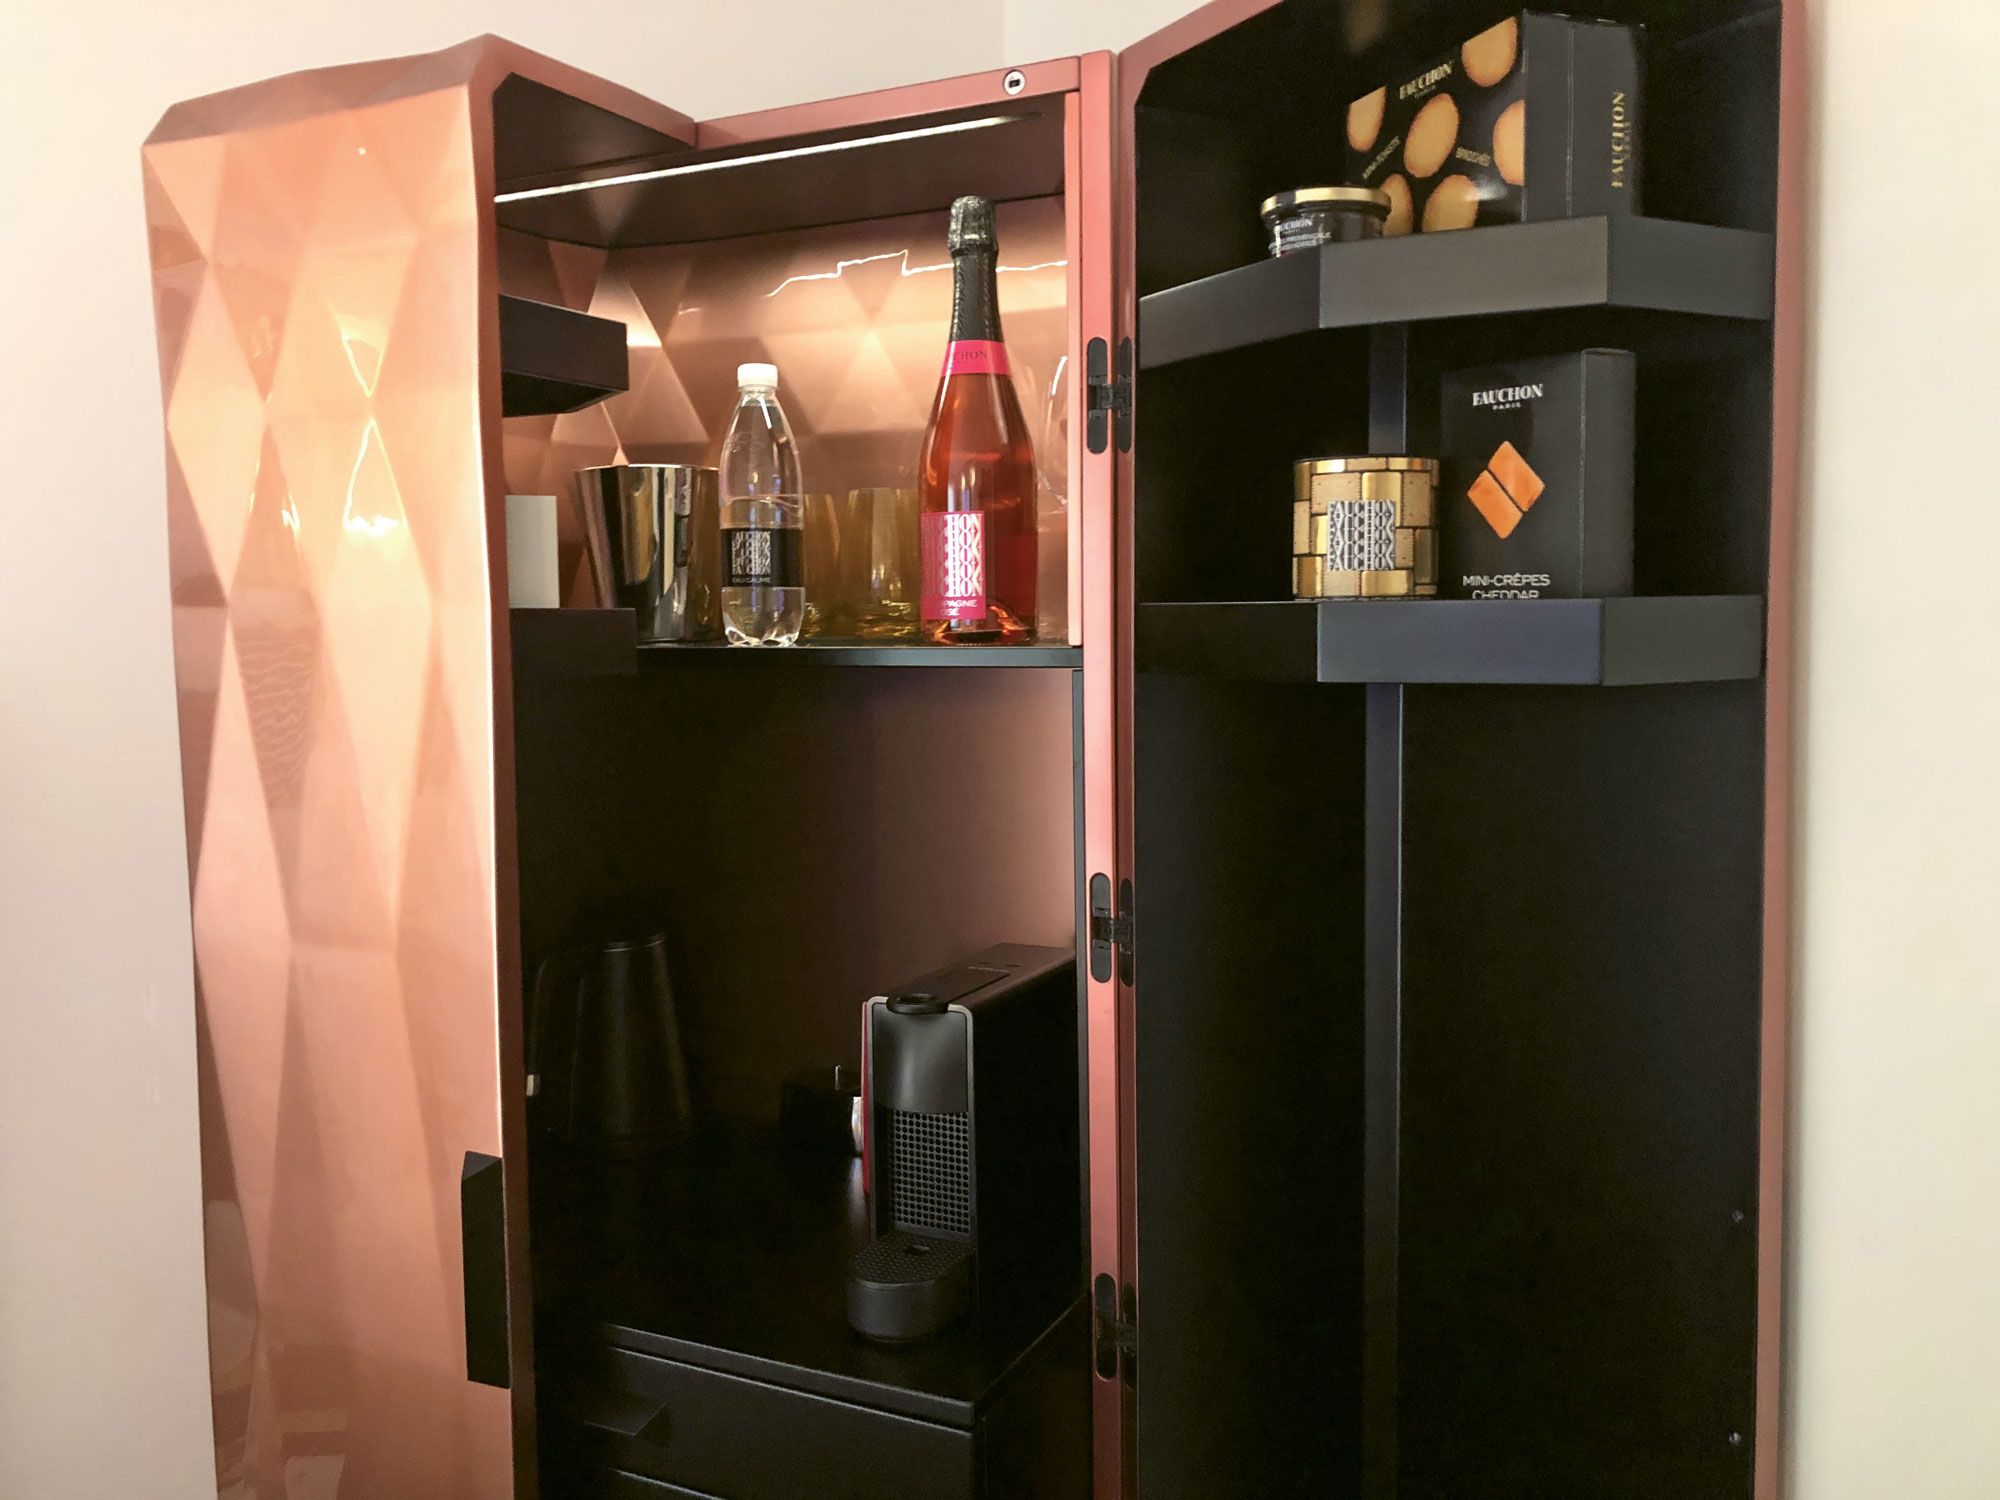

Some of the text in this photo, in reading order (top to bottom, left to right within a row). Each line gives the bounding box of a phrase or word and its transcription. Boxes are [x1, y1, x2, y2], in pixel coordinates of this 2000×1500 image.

[1611, 90, 1625, 188] FAUCHON
[1472, 383, 1544, 407] FAUCHON
[1492, 401, 1521, 411] PARIS
[1462, 572, 1551, 587] MINI-CRÊPES
[1471, 589, 1540, 600] CHEDDAR
